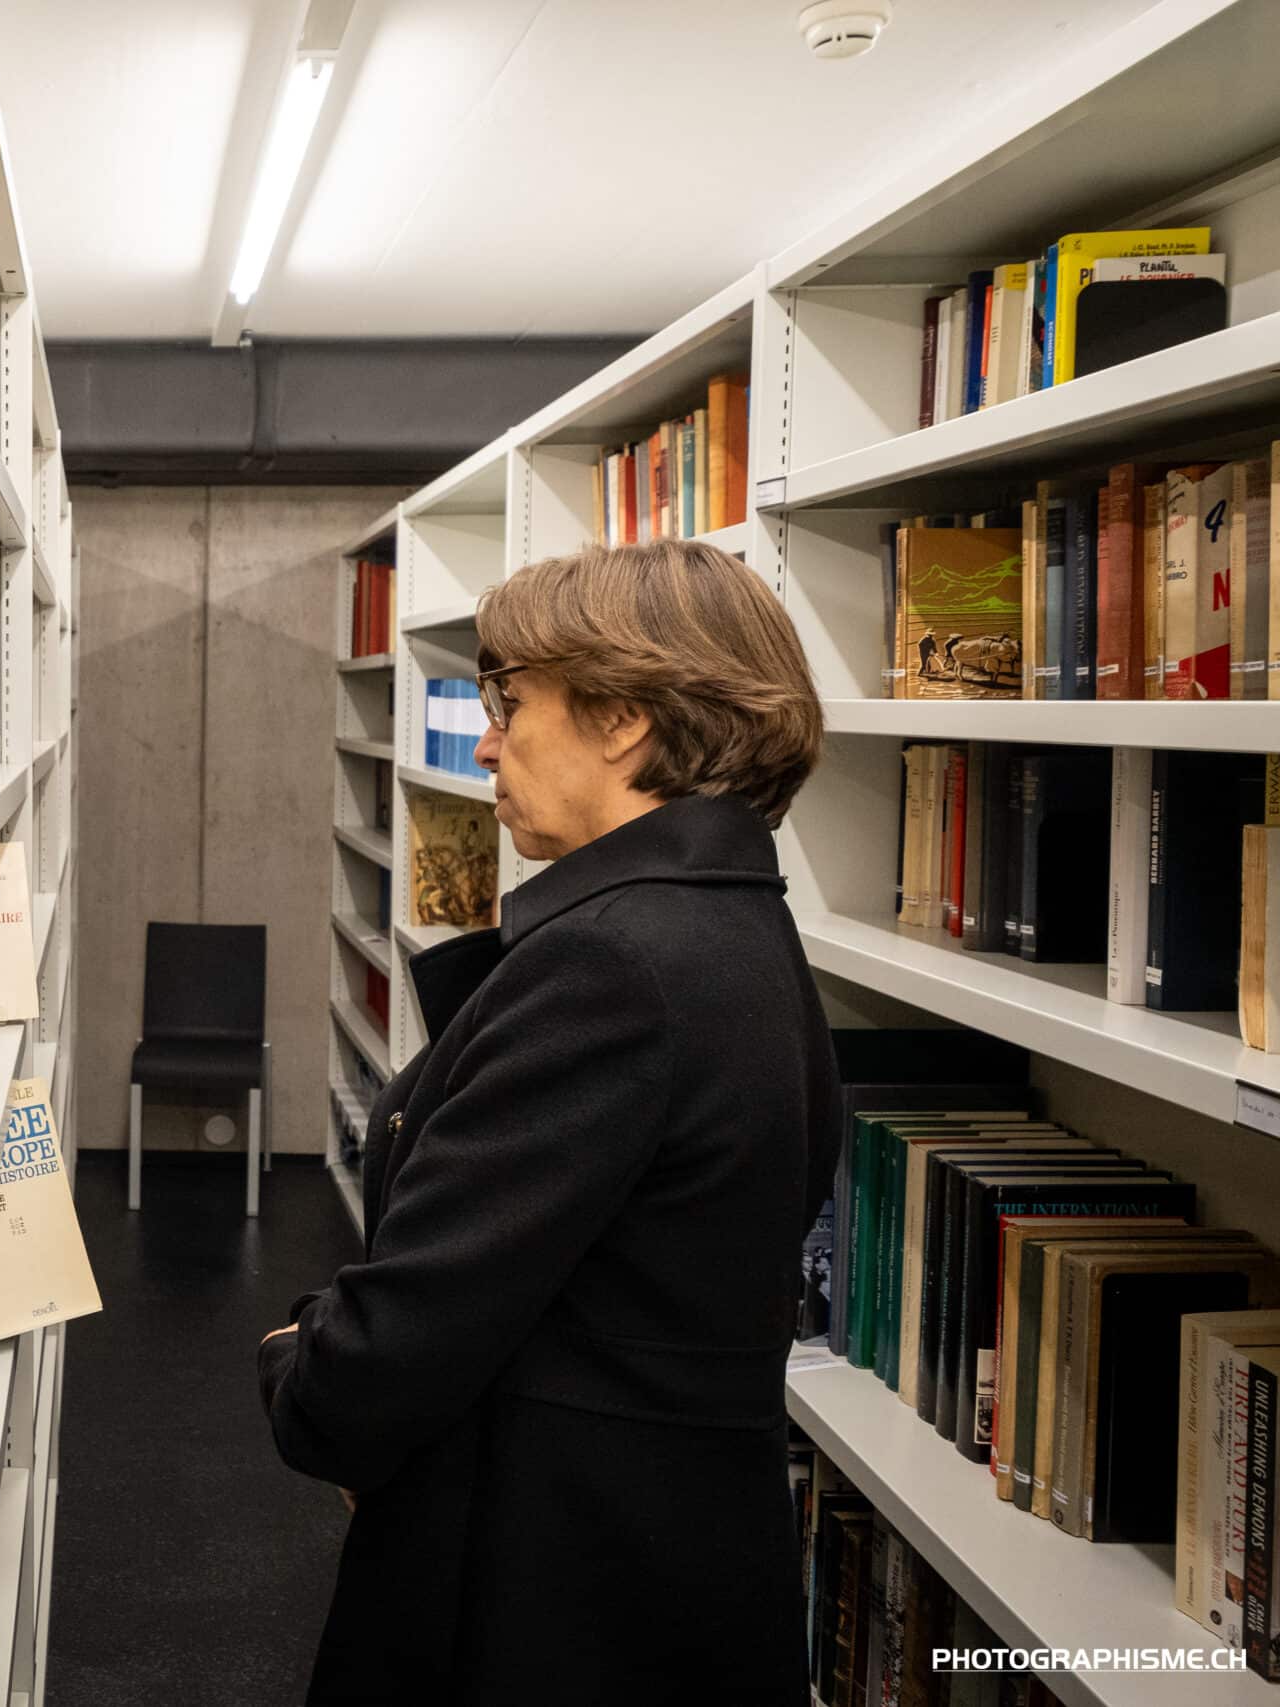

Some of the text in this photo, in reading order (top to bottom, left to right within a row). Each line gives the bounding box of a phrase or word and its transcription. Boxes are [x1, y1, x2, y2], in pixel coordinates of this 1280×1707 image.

[1140, 260, 1178, 272] PLANTU
[1204, 499, 1227, 543] 4
[1253, 1379, 1270, 1479] UNLEASHING
[1232, 1368, 1249, 1553] FIRE AND FURY
[1251, 1482, 1267, 1550] DEMONS
[1247, 1594, 1257, 1632] OLIVER
[1256, 1602, 1265, 1634] CRAIG
